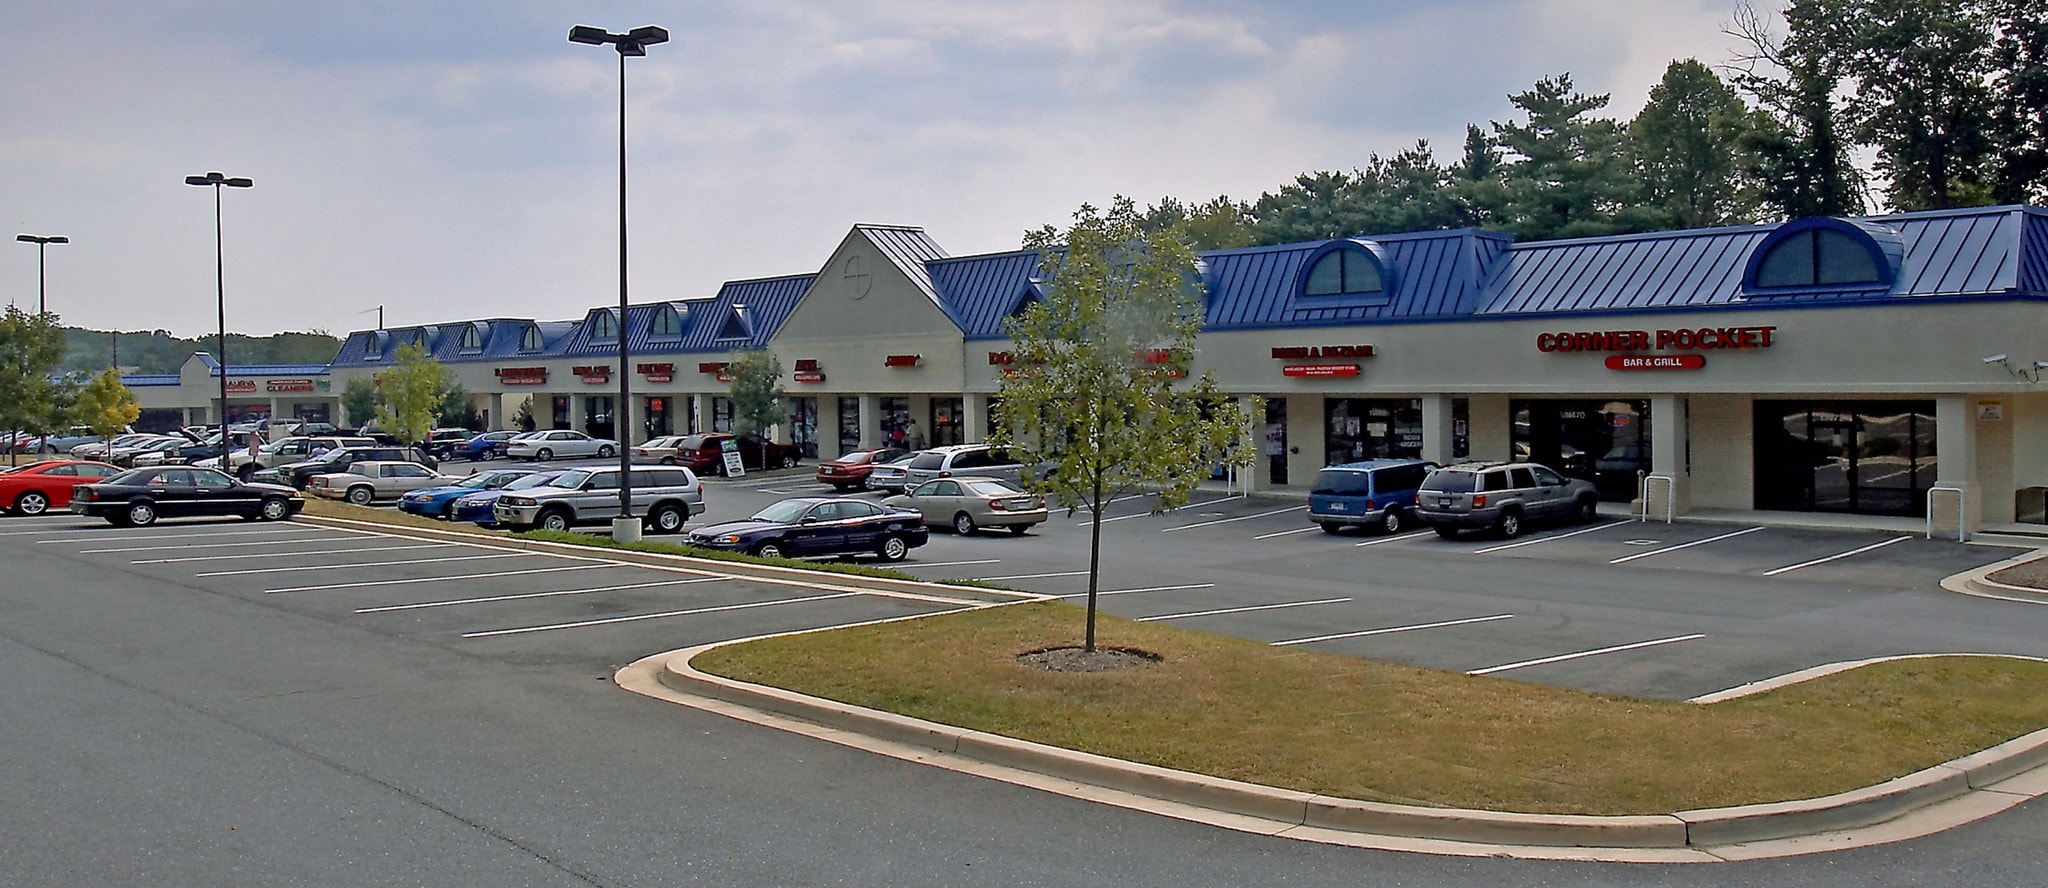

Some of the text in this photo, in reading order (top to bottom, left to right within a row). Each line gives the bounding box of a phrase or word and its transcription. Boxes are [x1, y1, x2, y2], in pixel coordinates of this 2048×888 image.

[1537, 326, 1777, 352] CORNER POCKET
[1623, 357, 1682, 367] BAR & GRILL
